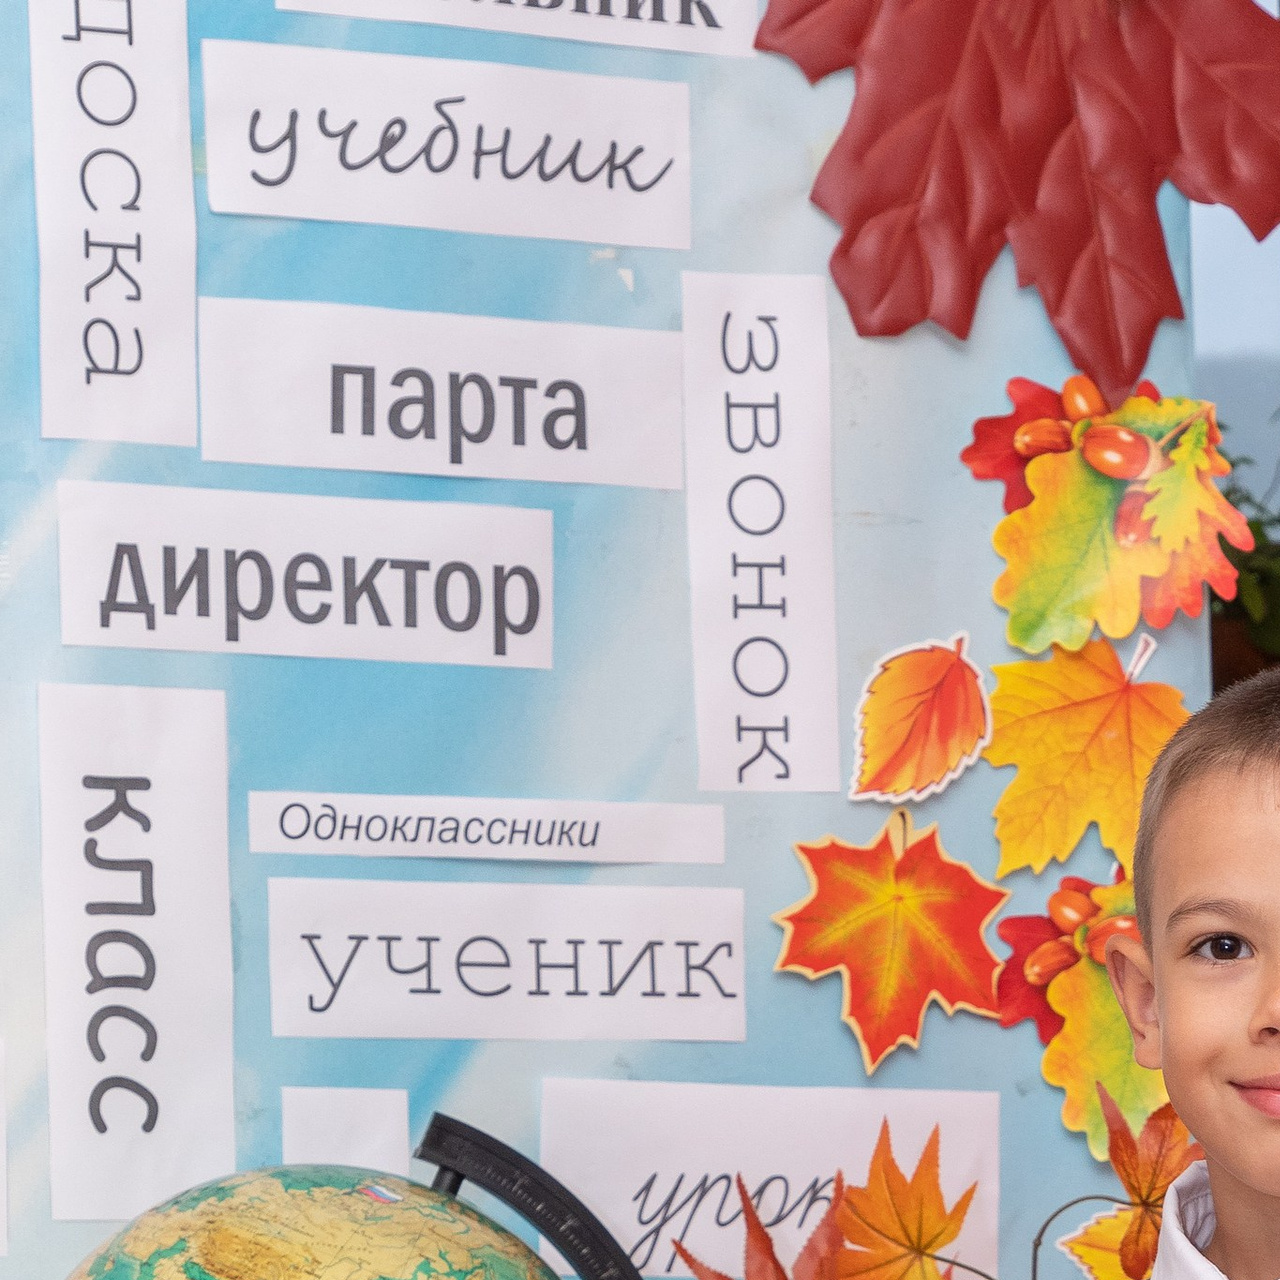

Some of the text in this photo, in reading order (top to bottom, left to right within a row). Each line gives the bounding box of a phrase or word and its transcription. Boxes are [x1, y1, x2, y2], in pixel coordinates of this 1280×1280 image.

[248, 96, 675, 193] учебник
[329, 362, 589, 464] парта
[99, 541, 541, 656] директор
[721, 311, 791, 784] звонок
[279, 802, 601, 850] Одноклассники
[82, 774, 159, 1135] класс
[301, 931, 738, 1013] ученик
